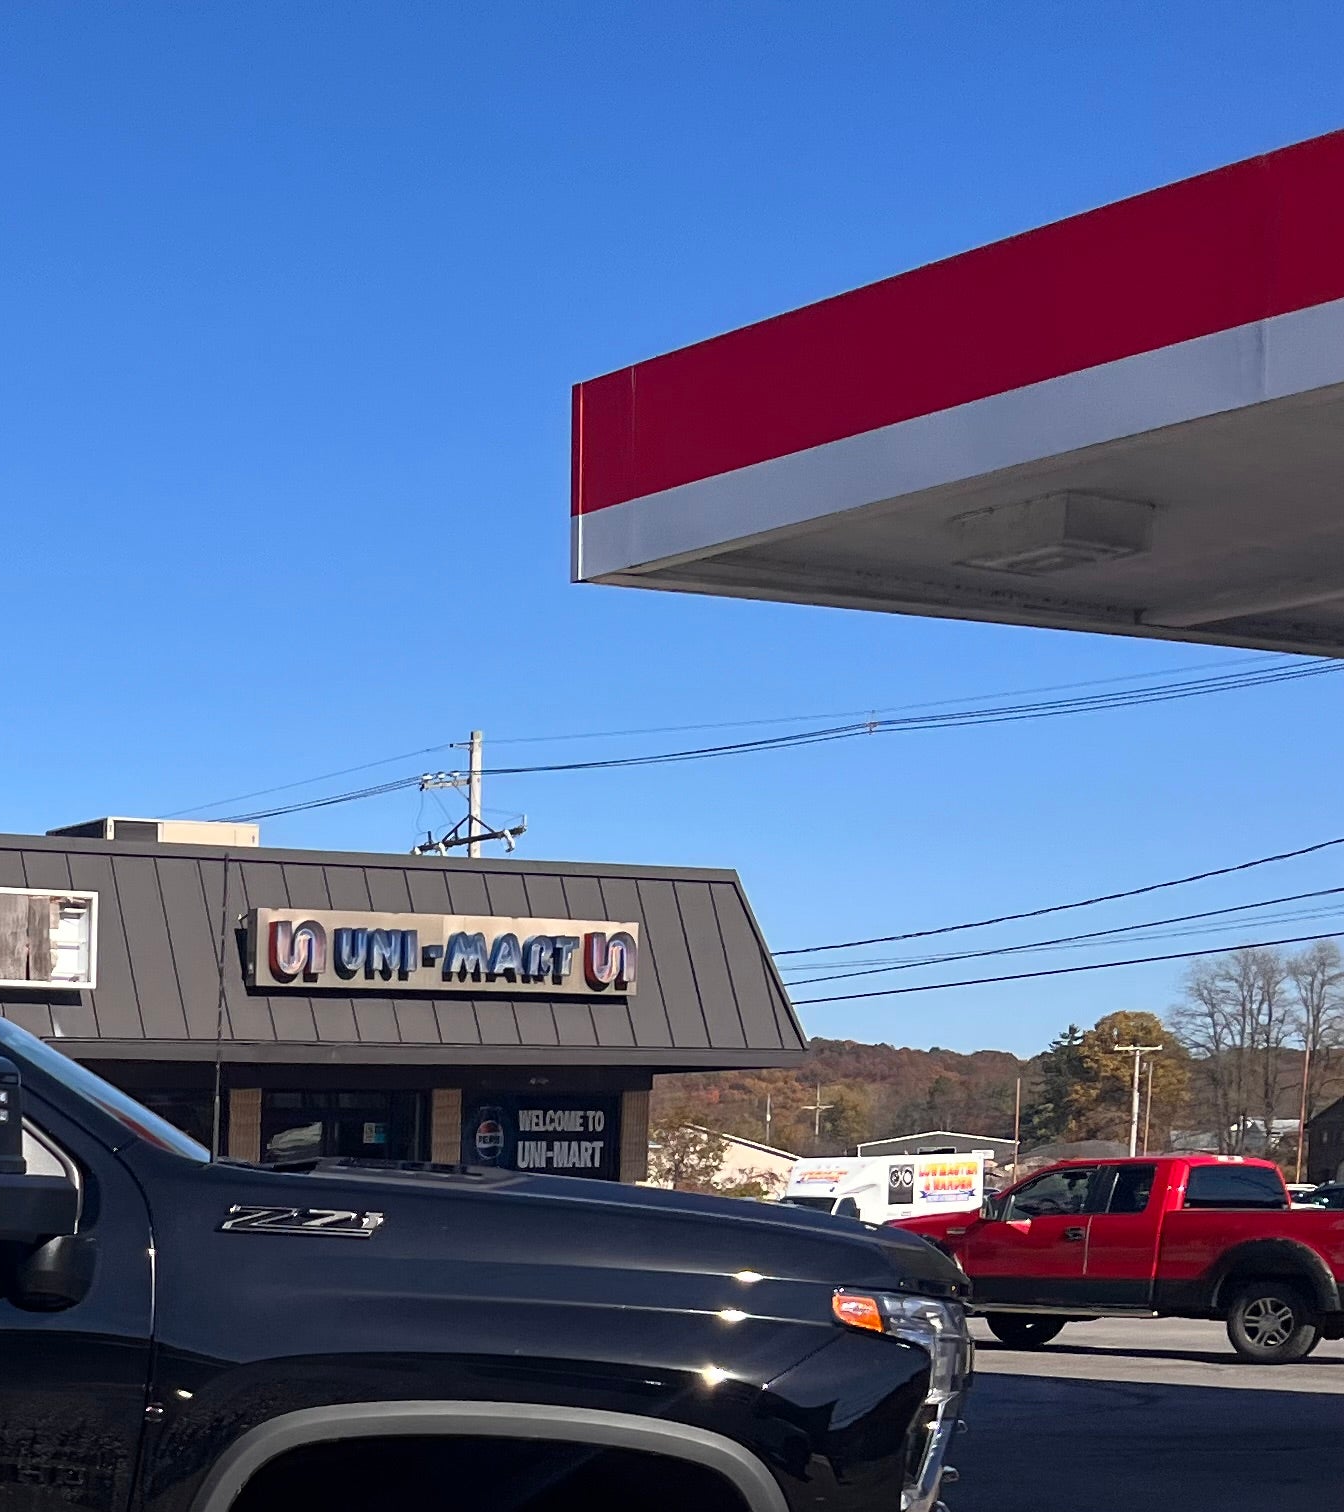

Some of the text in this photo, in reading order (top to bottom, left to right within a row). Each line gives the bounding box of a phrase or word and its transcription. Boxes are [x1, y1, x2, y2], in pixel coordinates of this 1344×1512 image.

[334, 928, 579, 985] UNI-MART
[519, 1110, 605, 1132] WELCOME TO
[517, 1141, 604, 1168] UNI-MART
[221, 1204, 384, 1238] Z71
